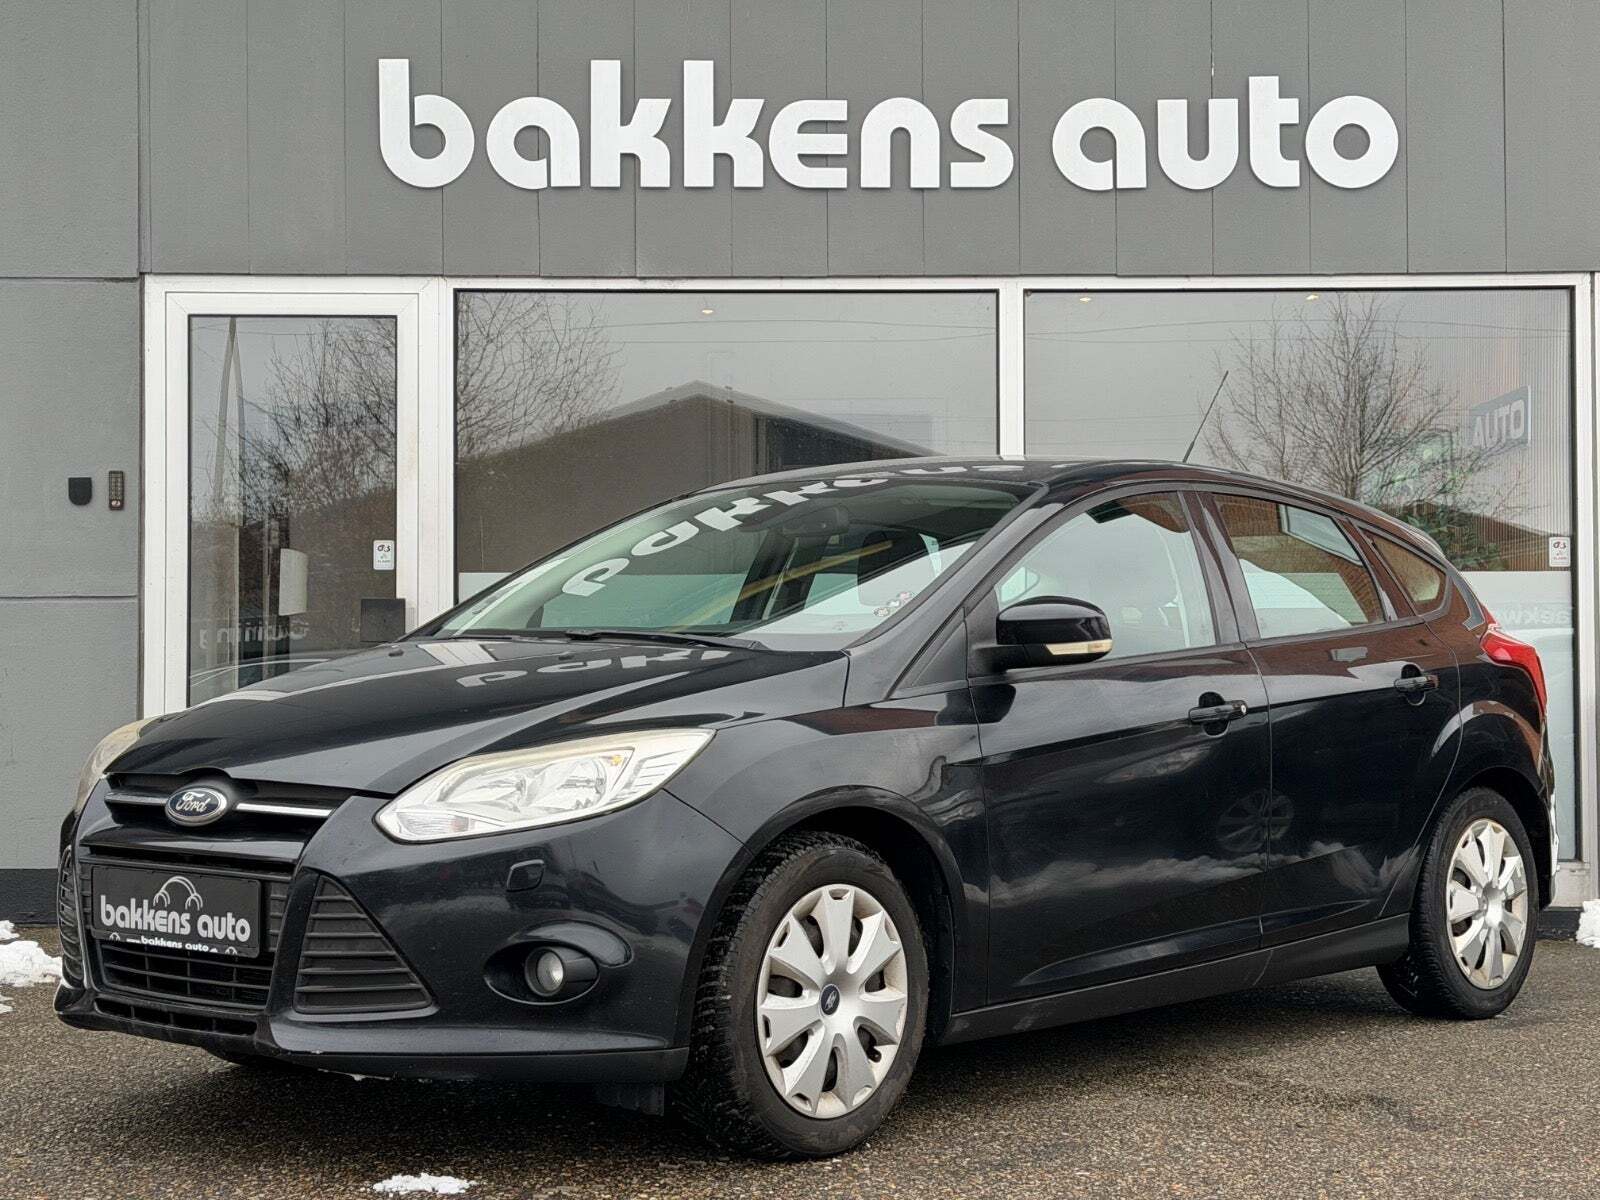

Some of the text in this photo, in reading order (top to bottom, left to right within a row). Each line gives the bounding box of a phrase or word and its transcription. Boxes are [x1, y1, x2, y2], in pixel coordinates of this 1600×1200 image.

[378, 58, 1399, 191] bakkens auto
[1471, 399, 1525, 449] AUTO
[175, 791, 211, 812] Ford
[100, 894, 251, 942] bakkens auto
